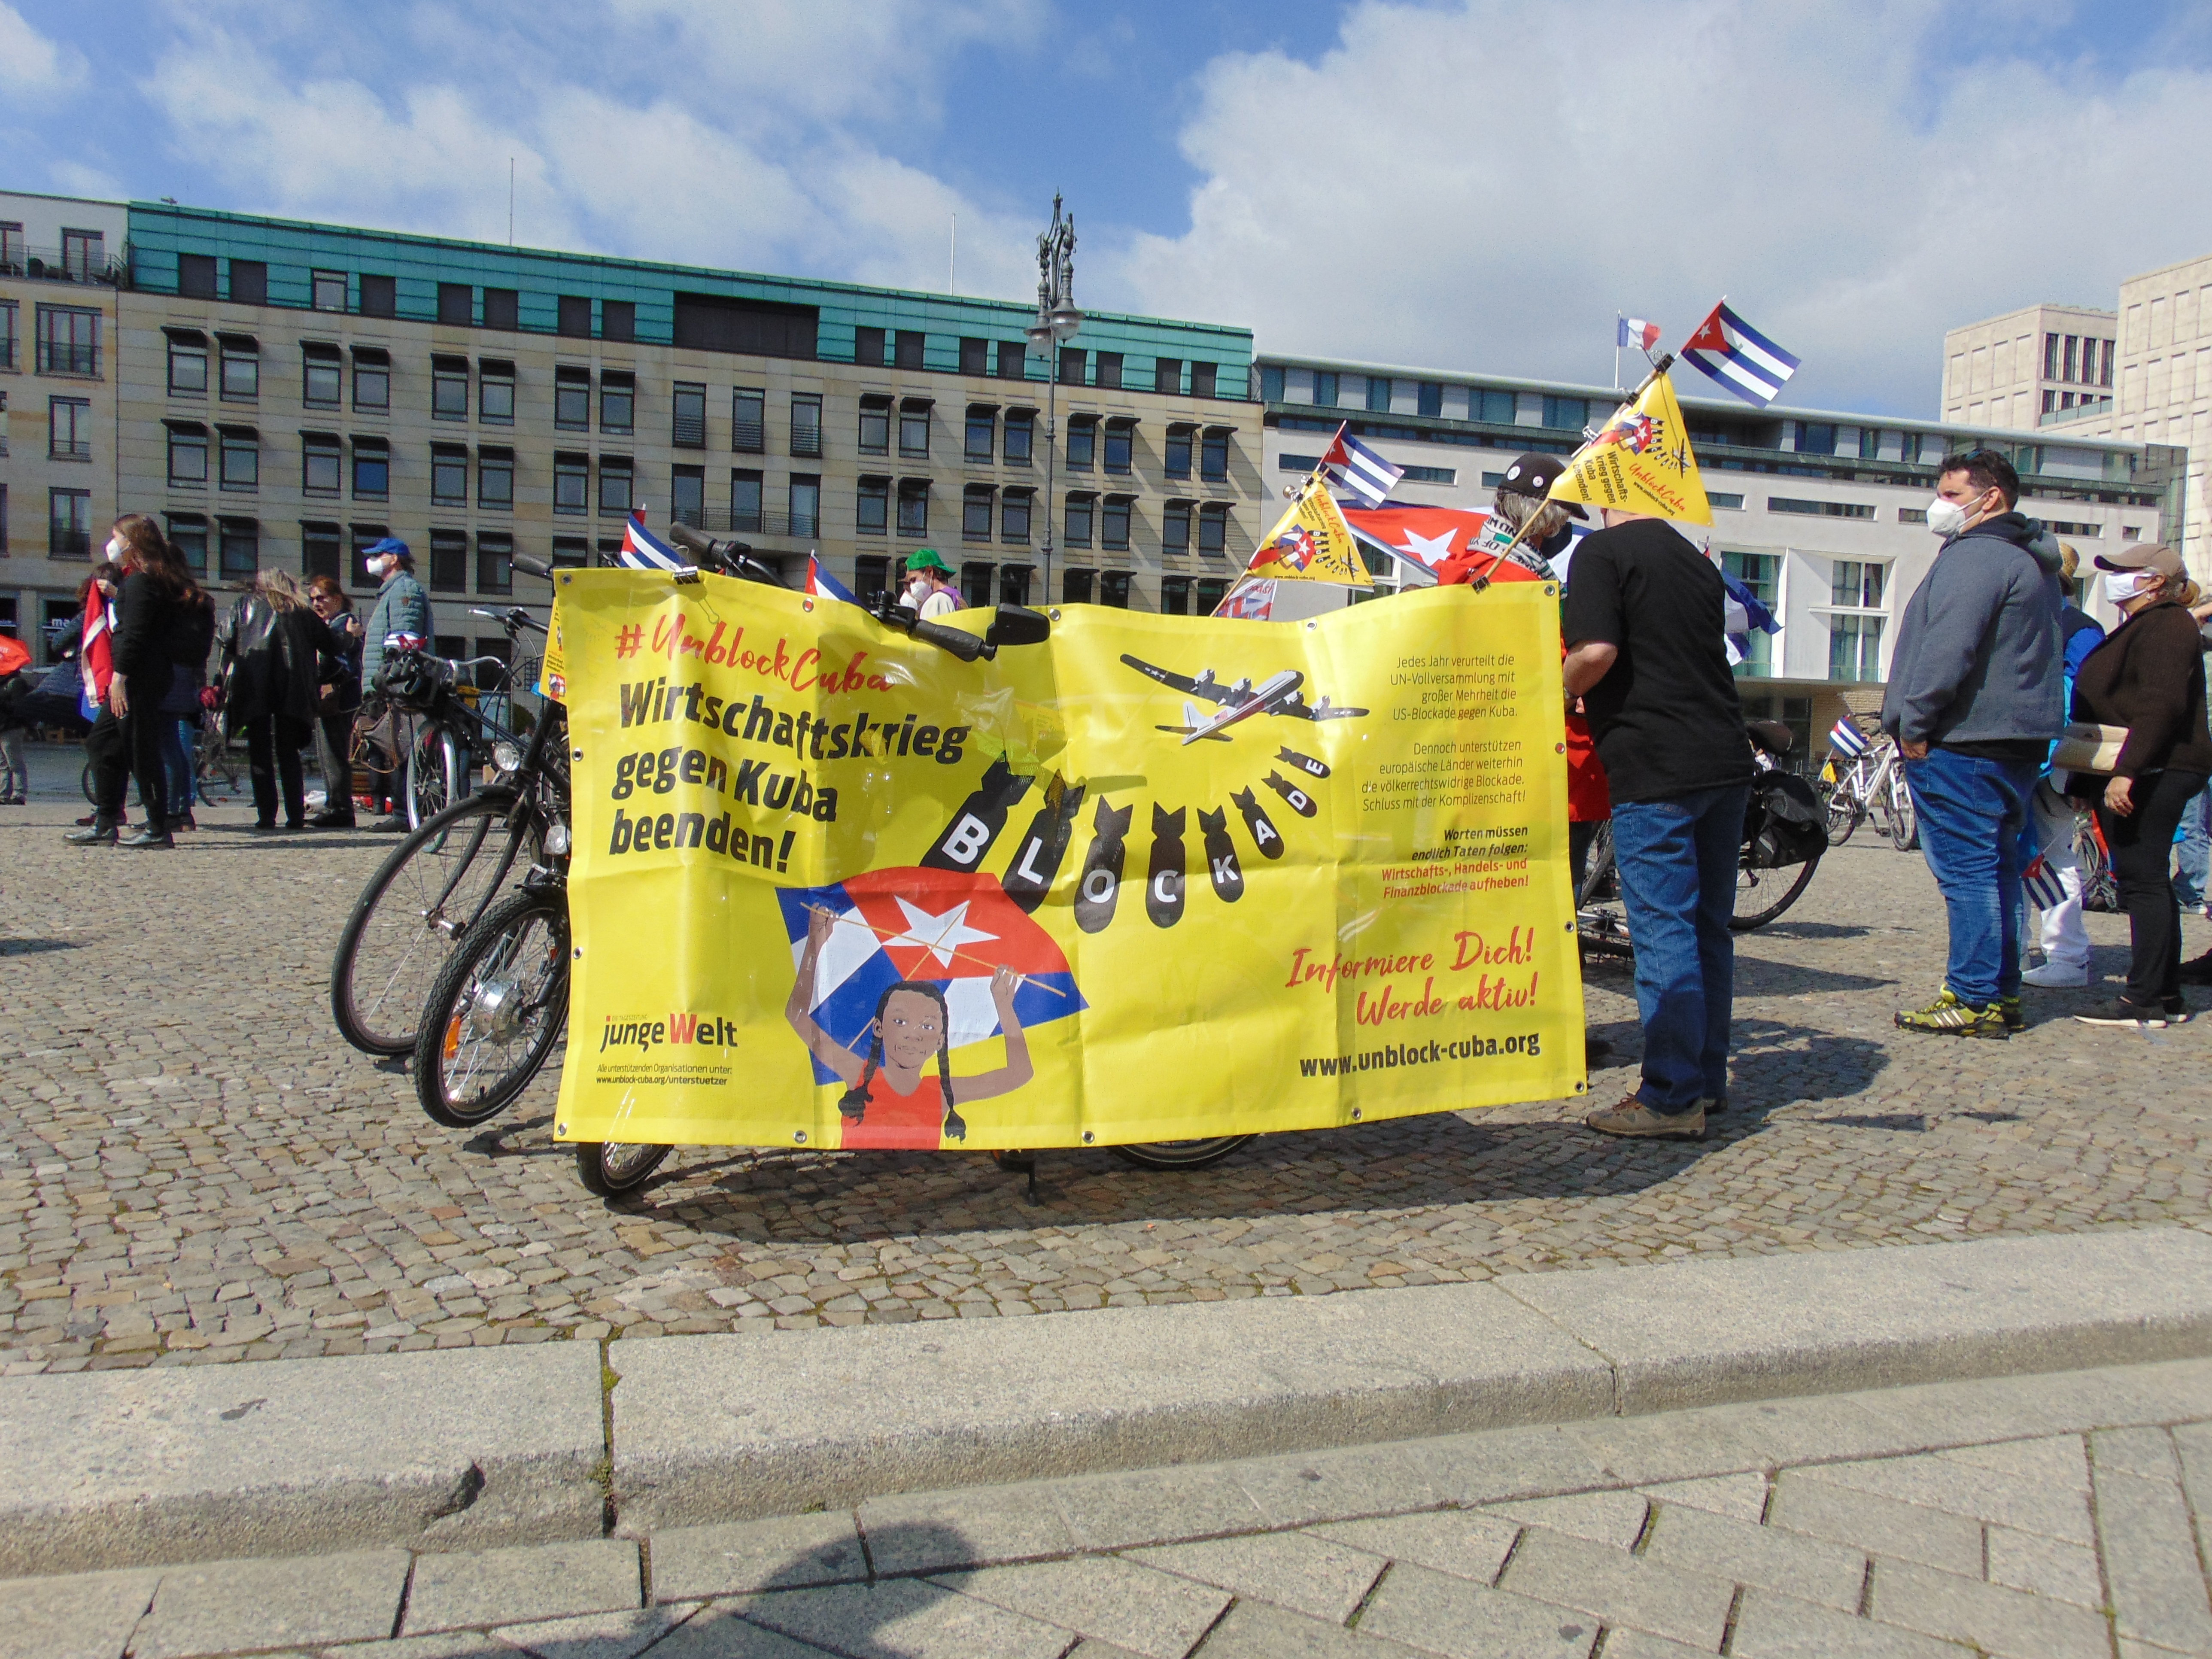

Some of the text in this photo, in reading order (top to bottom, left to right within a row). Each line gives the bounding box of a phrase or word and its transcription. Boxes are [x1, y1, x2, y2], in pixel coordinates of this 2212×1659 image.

[1584, 459, 1596, 480] Kuba
[1595, 455, 1616, 504] krieg gegen
[1607, 450, 1628, 503] Wirtschafts-
[1573, 464, 1592, 501] beenden!
[1629, 463, 1686, 512] UnblockCuba
[615, 613, 896, 695] #UnblockCuba
[1397, 653, 1515, 668] Jedes Jahr verurteilt die
[1390, 670, 1516, 686] UN-Vollversammlung mit
[1421, 688, 1517, 704] großer Mehrheit die
[619, 676, 972, 765] Wirtschaftskrieg
[1393, 704, 1518, 720] US-Blockade gegen Kuba.
[1413, 740, 1522, 755] Dennoch unterstützen
[1379, 756, 1523, 775] europäische Länder weiterhin
[610, 746, 839, 823] gegen Kuba
[1361, 774, 1525, 793] die völkerrechtswidrige Blockade.
[1362, 790, 1526, 812] Schluss mit der Komplizenschaft!
[609, 808, 797, 874] beenden!
[1443, 826, 1528, 842] Worten müssen
[1412, 843, 1528, 861] endlich Taten folgen:
[1454, 860, 1504, 875] Handels-
[1506, 857, 1528, 870] und
[1383, 874, 1529, 899] Finanzblockade aufheben!
[1285, 925, 1534, 994] Informiere Dich!
[1356, 971, 1538, 1026] Werde aktiv!
[599, 1013, 738, 1054] junge Welt
[1299, 1032, 1540, 1078] www.unblock-cuba.org
[596, 1074, 728, 1085] www.unblock-cuba.org/unterstuetzer
[597, 1063, 732, 1075] Alle unterstützenden Organisationen unter:
